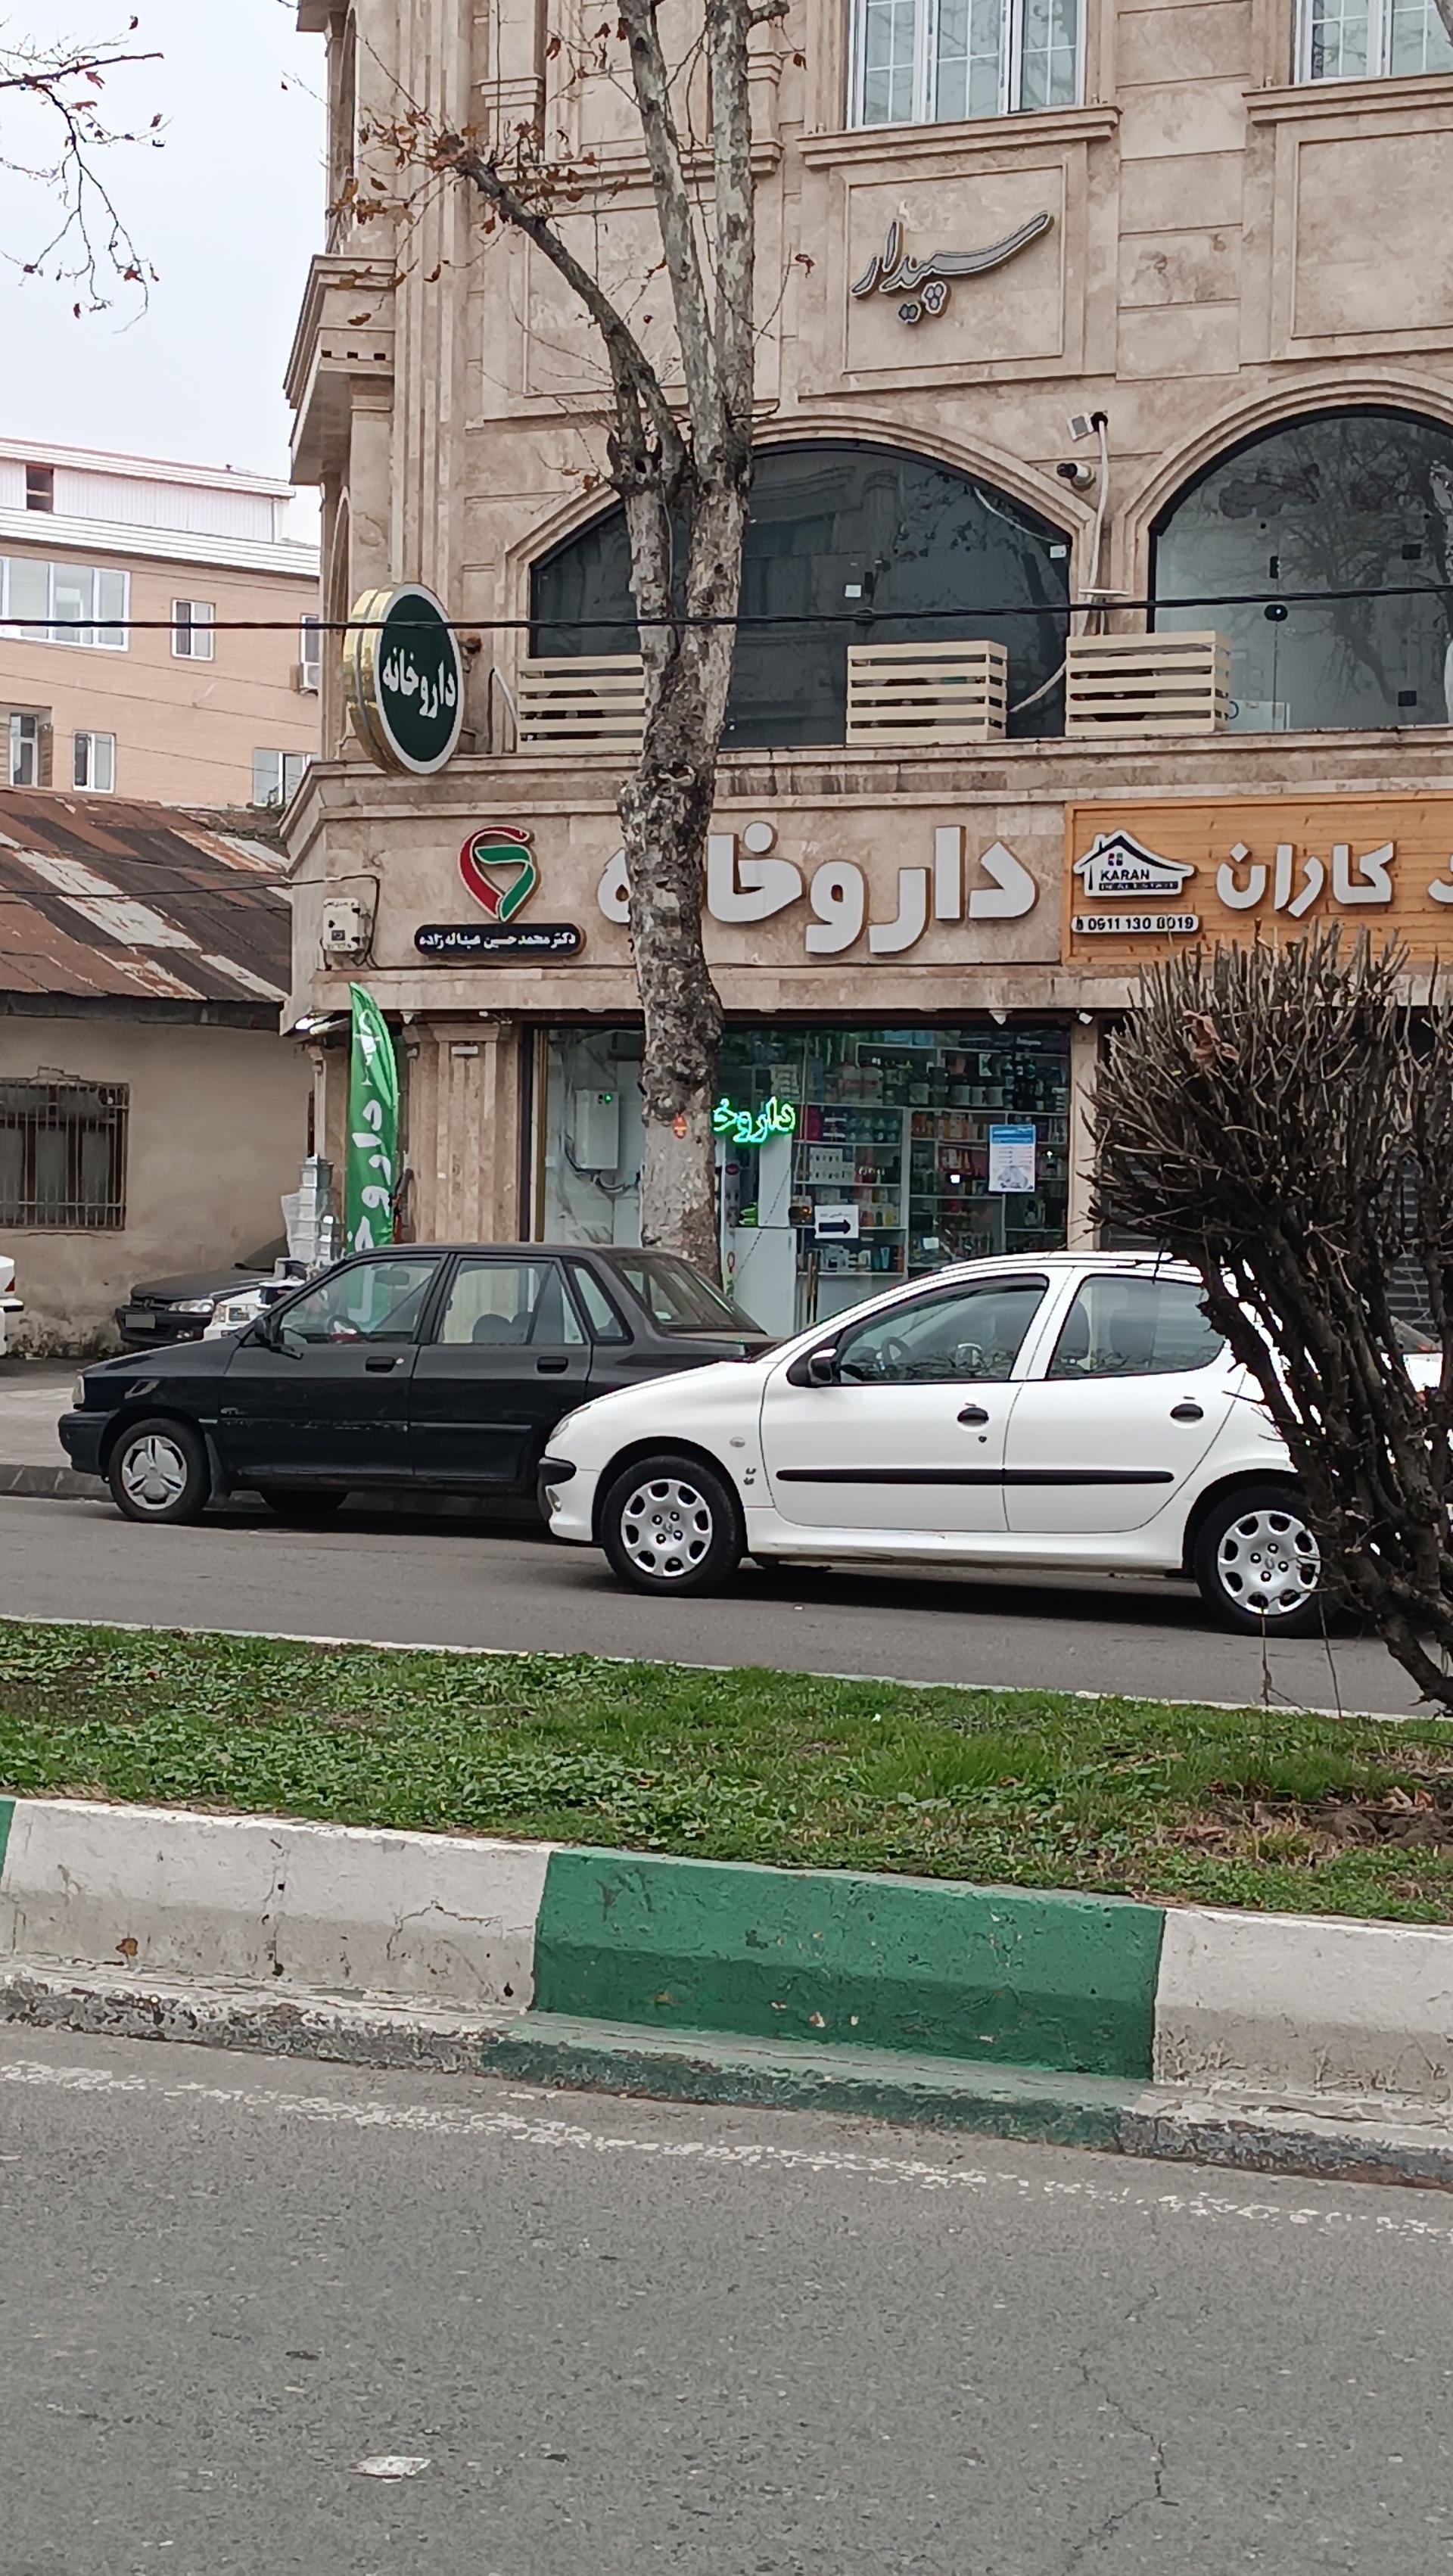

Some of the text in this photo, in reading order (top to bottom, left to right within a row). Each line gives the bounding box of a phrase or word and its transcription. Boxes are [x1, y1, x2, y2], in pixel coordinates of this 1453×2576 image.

[381, 646, 456, 719] داروخانه
[1100, 869, 1150, 882] KARAN
[1215, 842, 1394, 919] کاران
[596, 821, 1038, 954] داروخاه
[1088, 917, 1119, 930] 0911
[1125, 916, 1152, 930] 130
[518, 935, 550, 945] محمد
[550, 932, 576, 948] دکتر
